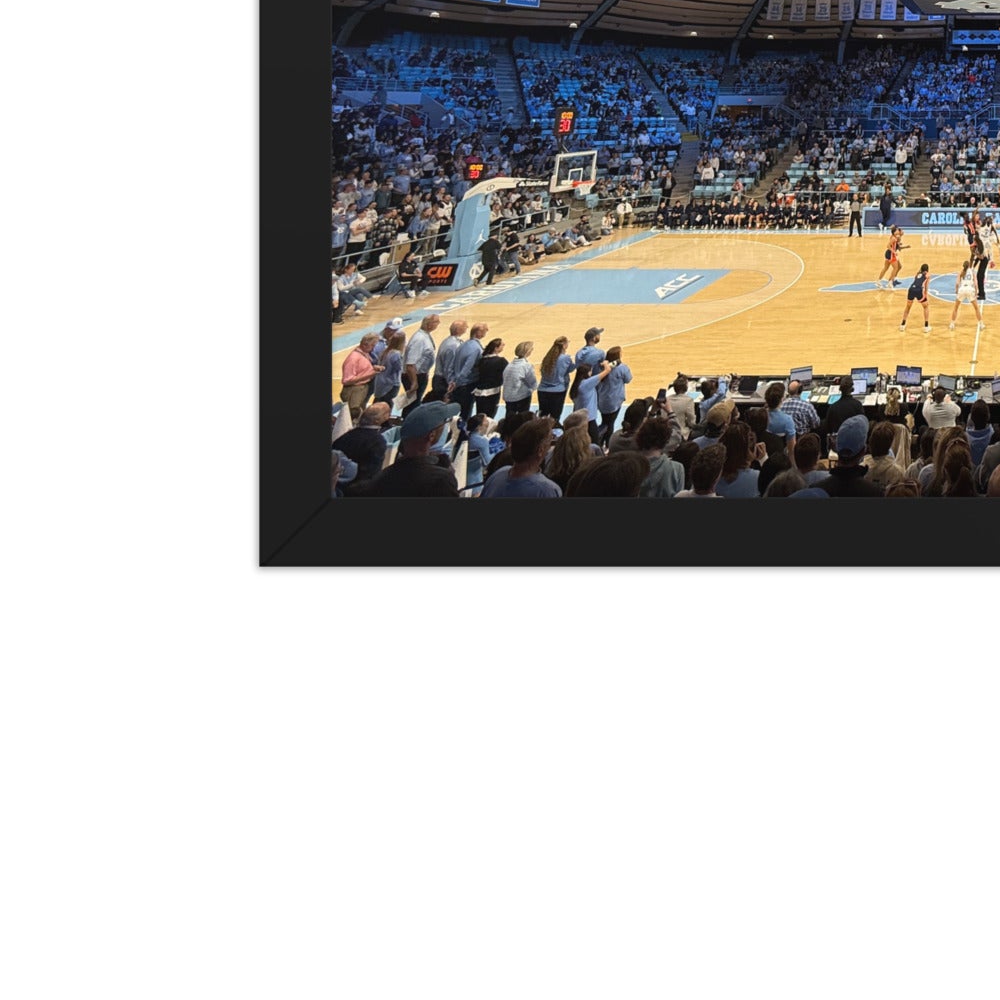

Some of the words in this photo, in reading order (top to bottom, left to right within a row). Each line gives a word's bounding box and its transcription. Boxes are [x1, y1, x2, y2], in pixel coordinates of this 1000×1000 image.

[558, 119, 571, 133] 30
[469, 170, 480, 179] 30
[427, 265, 453, 279] CW
[654, 272, 701, 299] ACC
